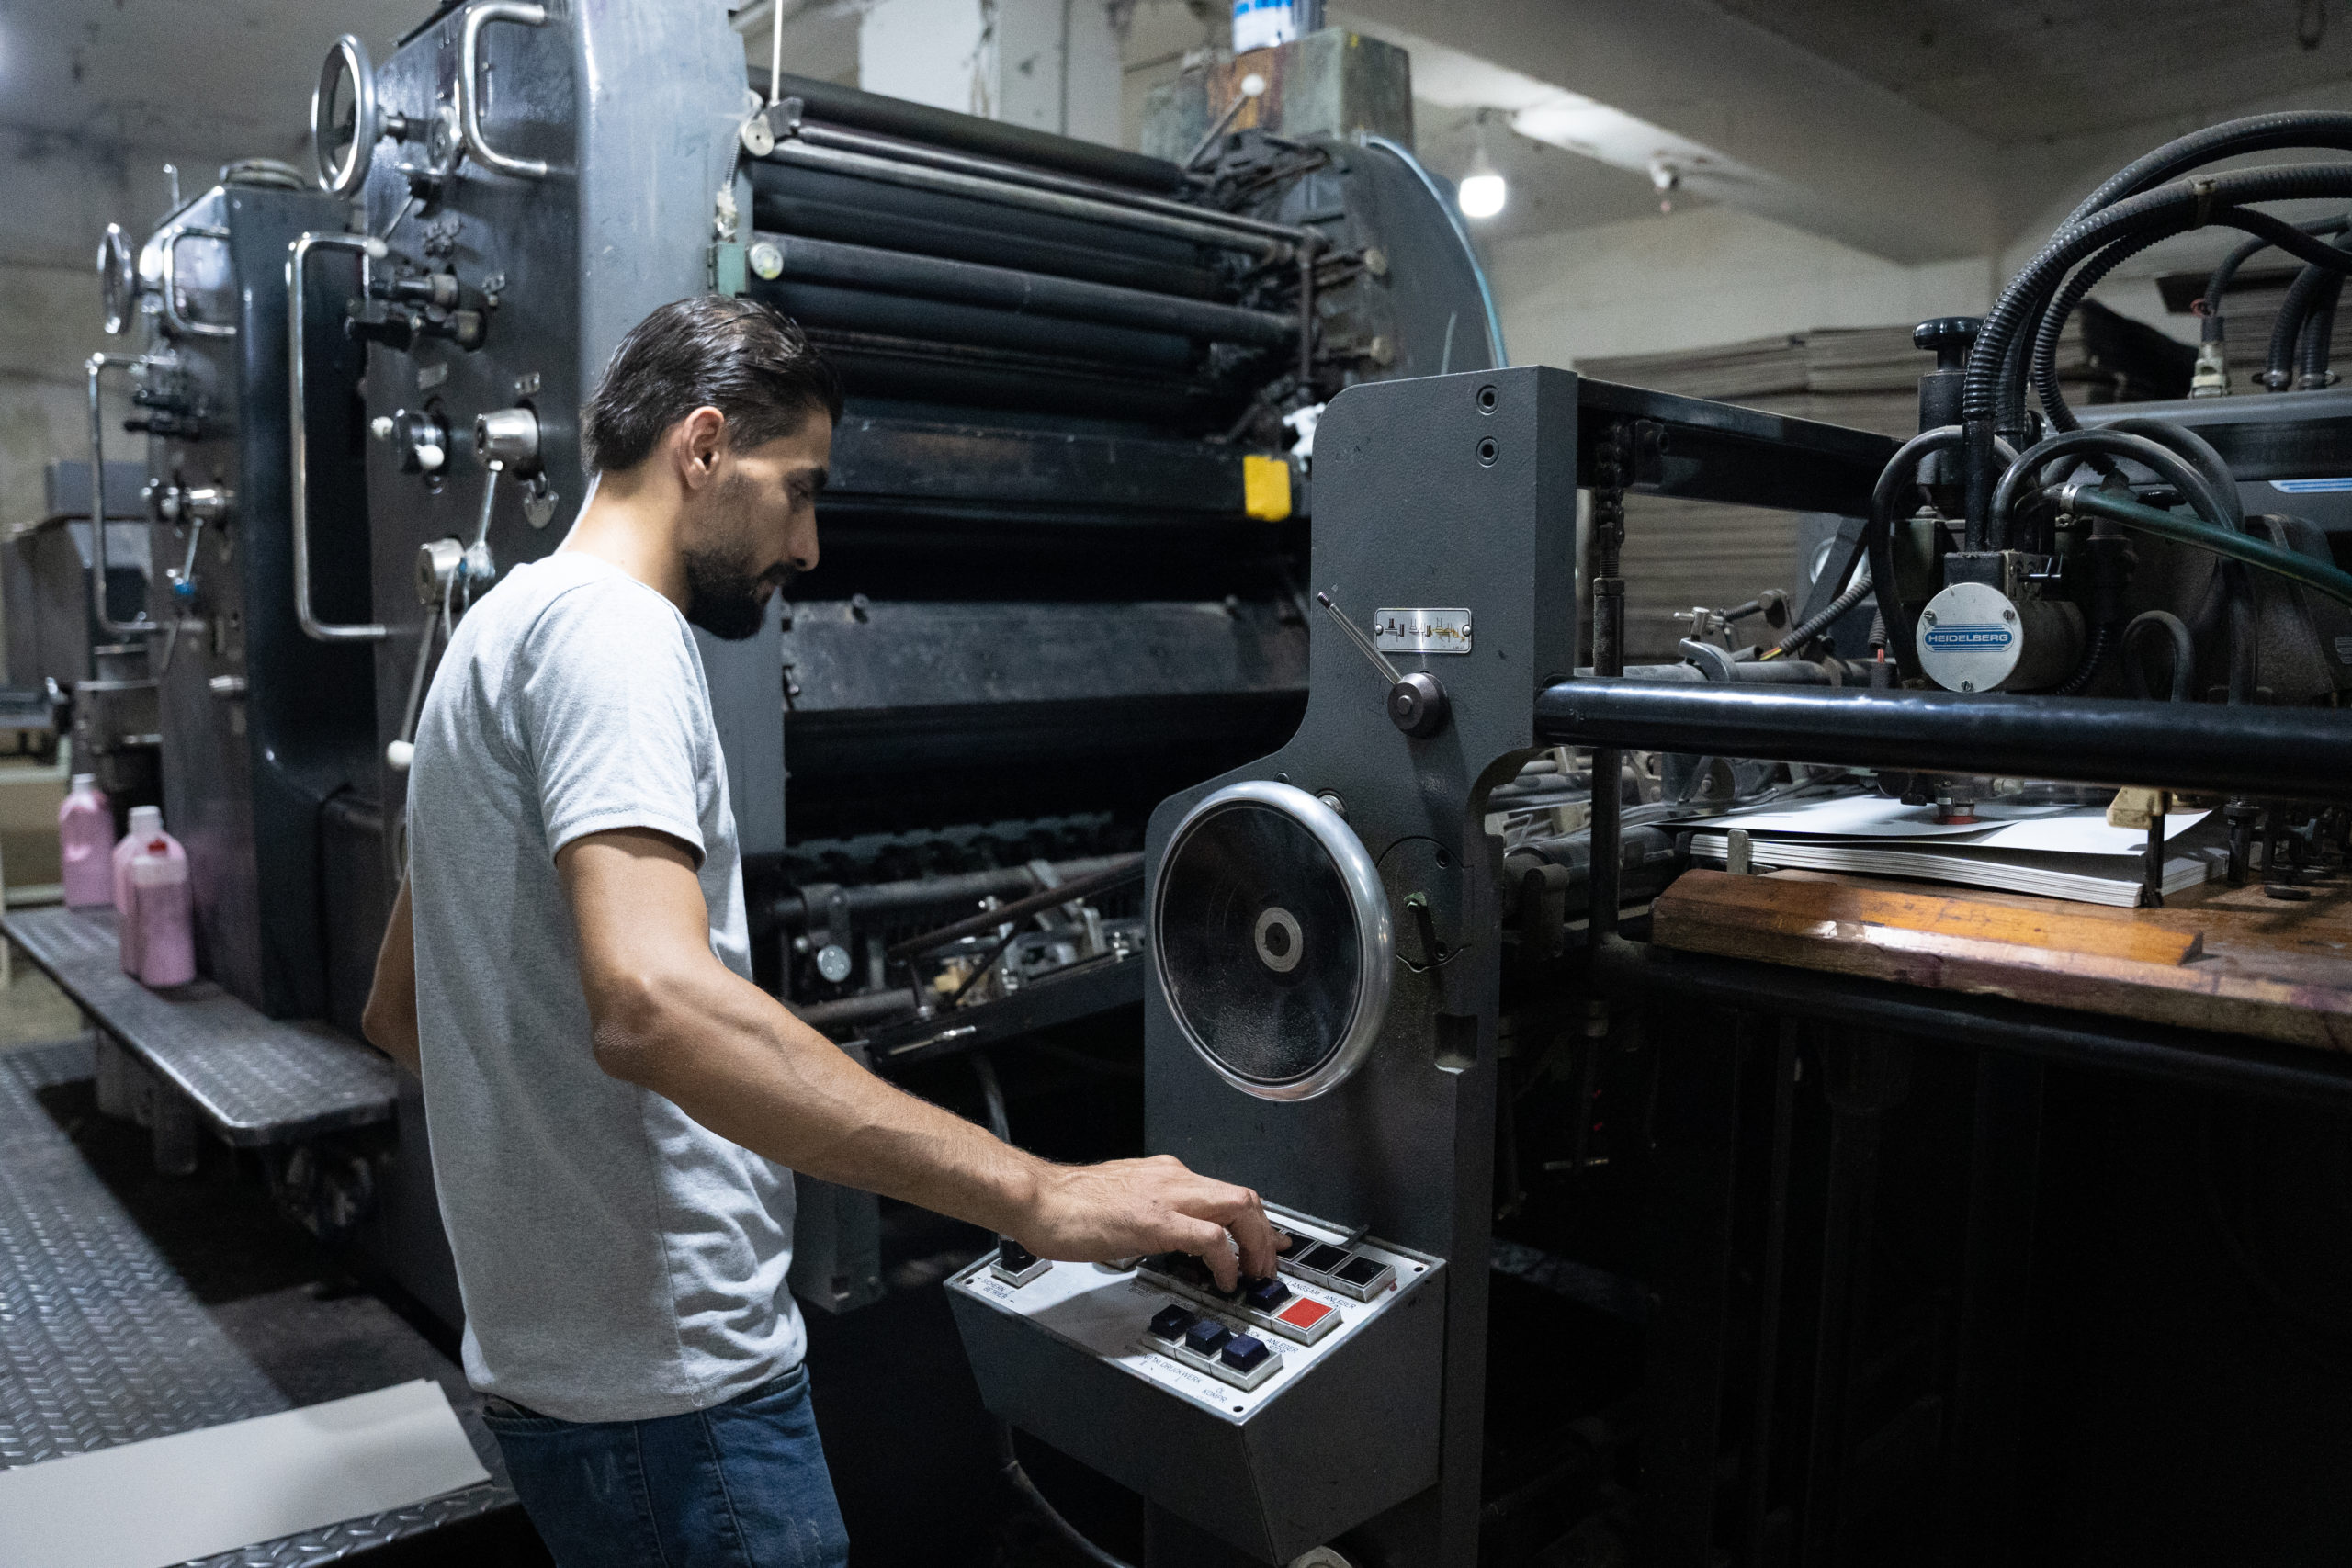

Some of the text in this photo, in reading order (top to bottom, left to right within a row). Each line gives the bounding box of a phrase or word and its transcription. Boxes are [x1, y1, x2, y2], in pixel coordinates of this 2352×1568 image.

[1928, 634, 2008, 643] HEIDELBERG
[1286, 1280, 1320, 1295] LANGSAM
[1324, 1294, 1357, 1309] ANLEGER
[1267, 1337, 1299, 1353] ANLEGER
[1160, 1361, 1201, 1384] DRUCKWERK
